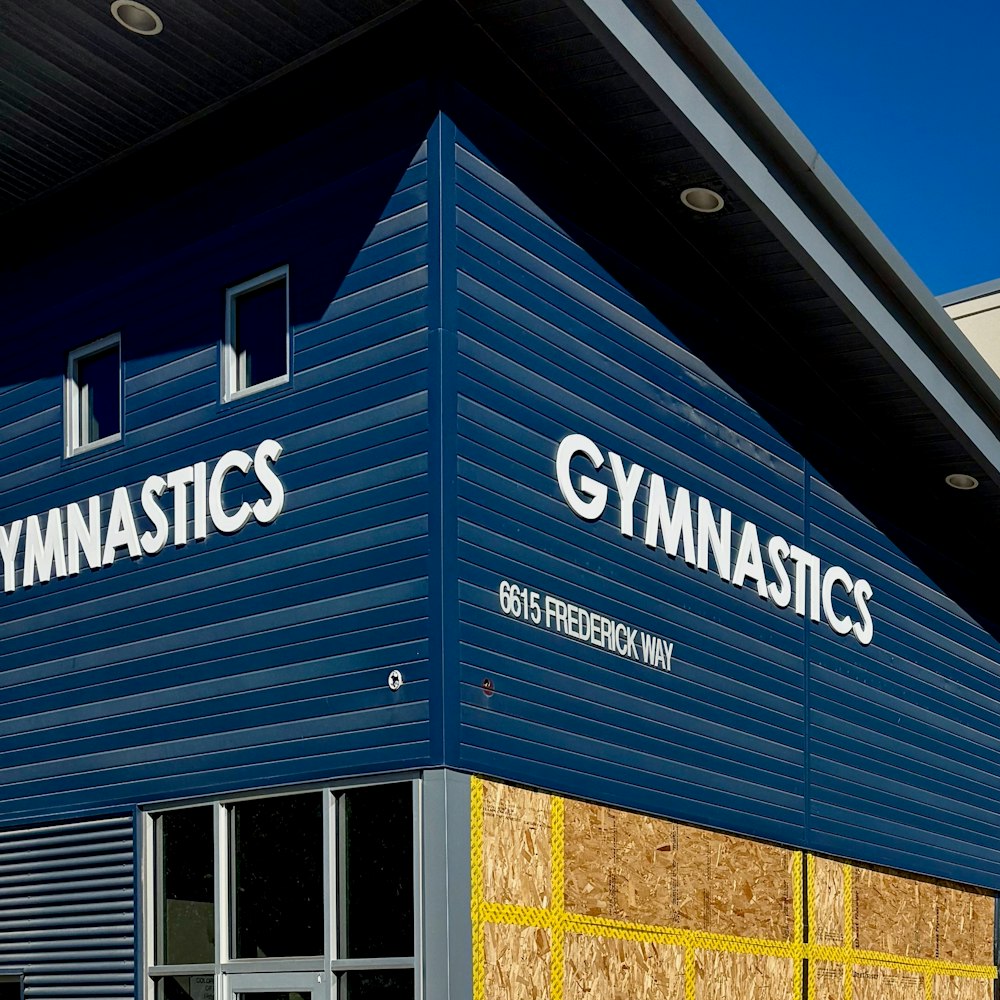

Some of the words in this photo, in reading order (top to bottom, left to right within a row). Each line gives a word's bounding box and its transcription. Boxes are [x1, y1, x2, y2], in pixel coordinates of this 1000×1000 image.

[555, 433, 874, 646] GYMNASTICS
[499, 580, 542, 625] 6615
[545, 595, 640, 661] FREDERICK
[640, 631, 674, 672] WAY
